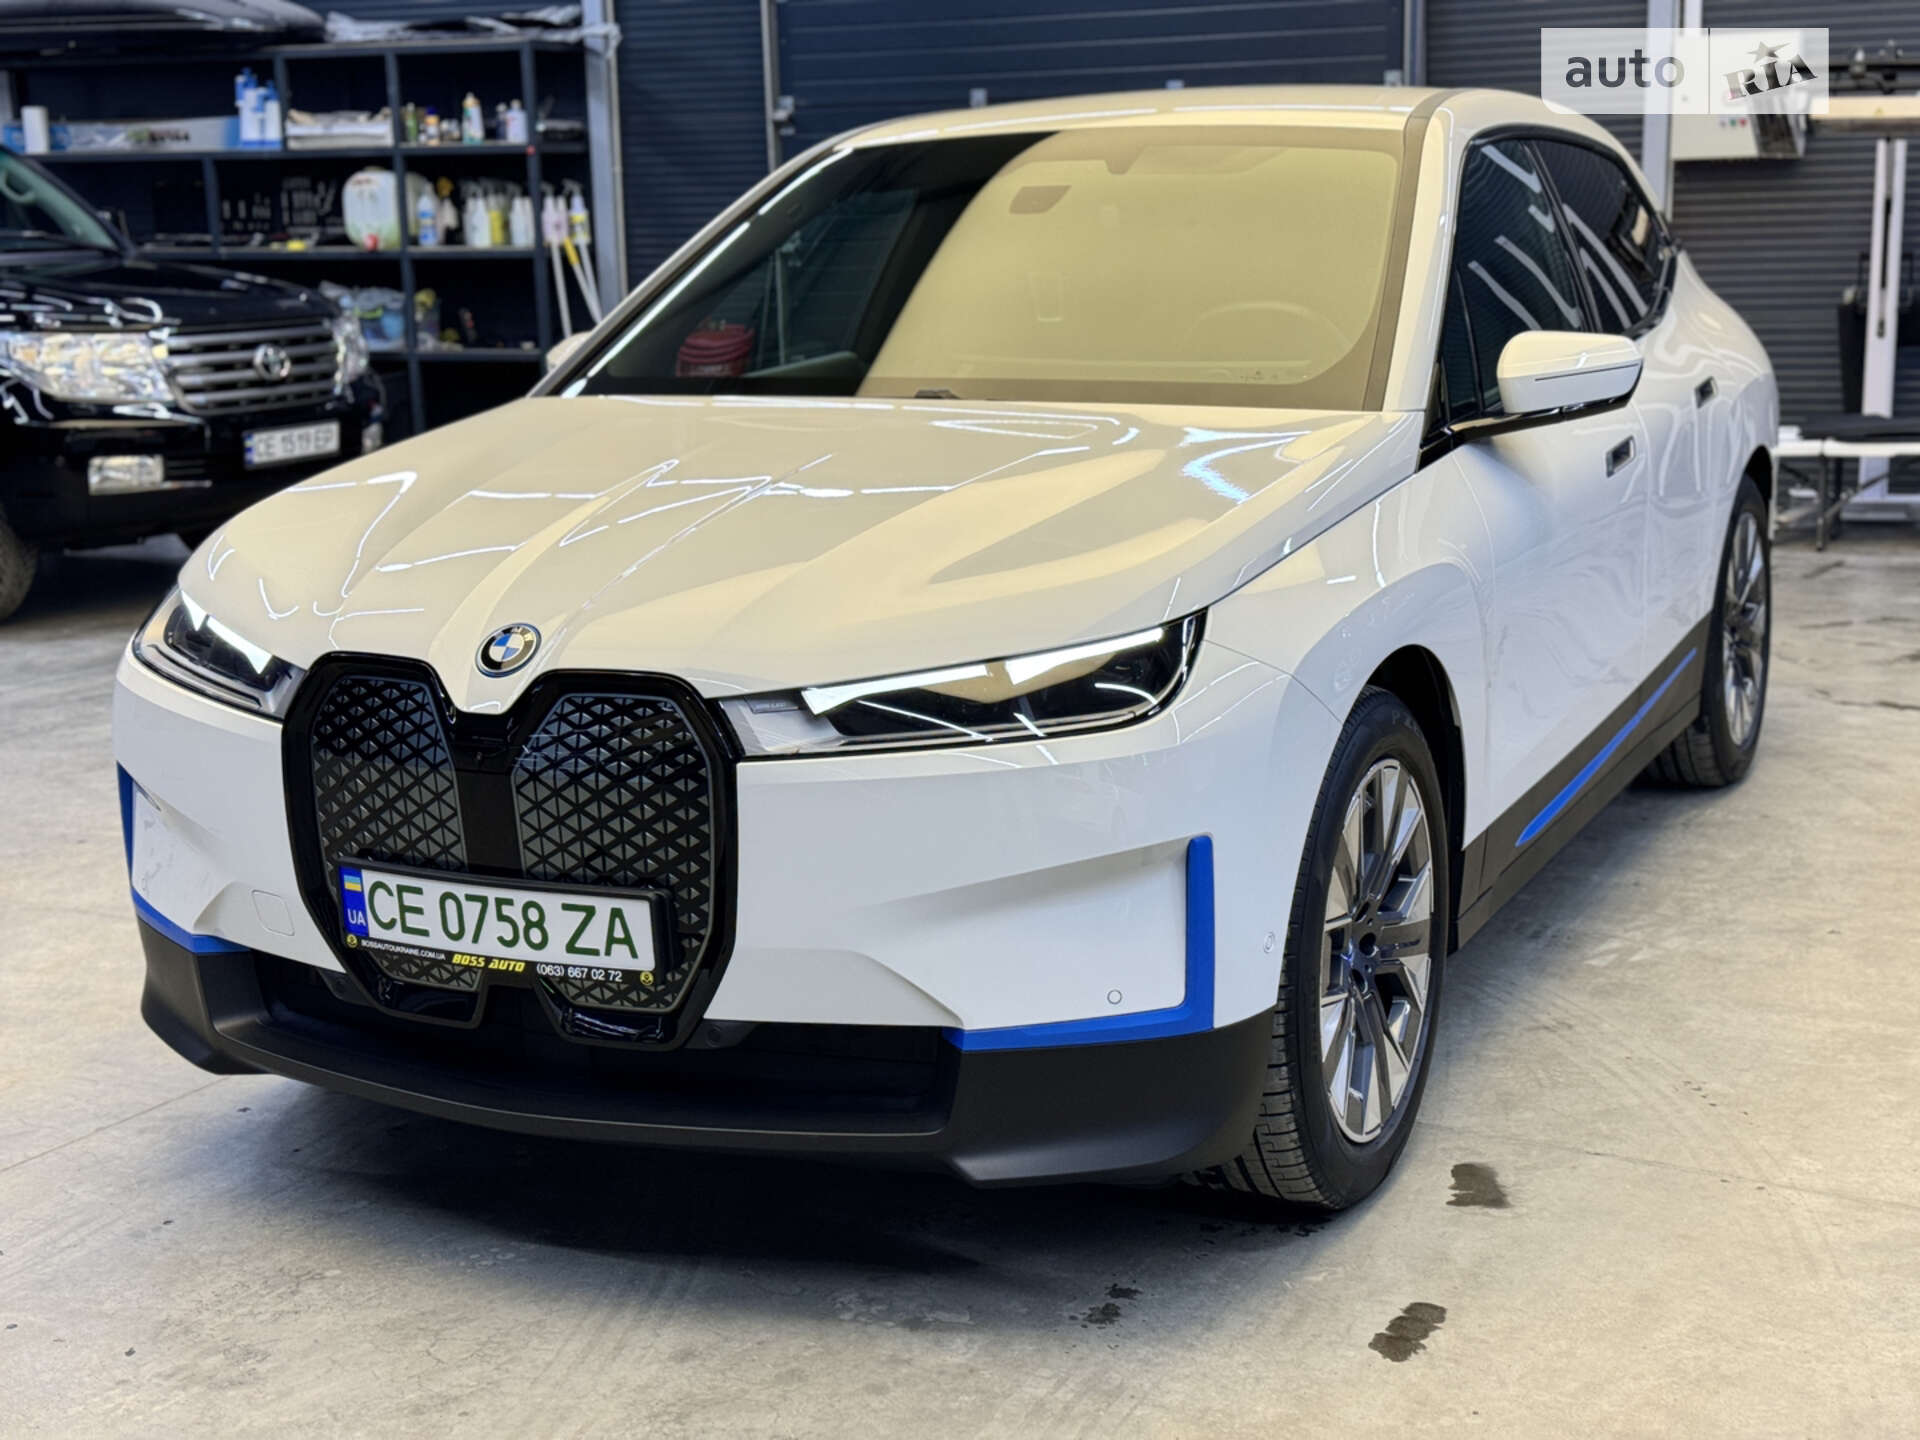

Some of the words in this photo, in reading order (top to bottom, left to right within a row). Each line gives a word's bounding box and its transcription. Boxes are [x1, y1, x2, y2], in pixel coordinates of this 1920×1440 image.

[347, 908, 367, 927] UA
[368, 881, 430, 937] CE
[439, 891, 549, 951] 0758
[561, 902, 639, 959] ZA
[452, 953, 486, 968] BOSS
[488, 959, 526, 973] AUTO
[536, 963, 565, 977] (063)
[567, 967, 588, 979] 667
[591, 969, 606, 981] 02
[609, 970, 623, 982] 72
